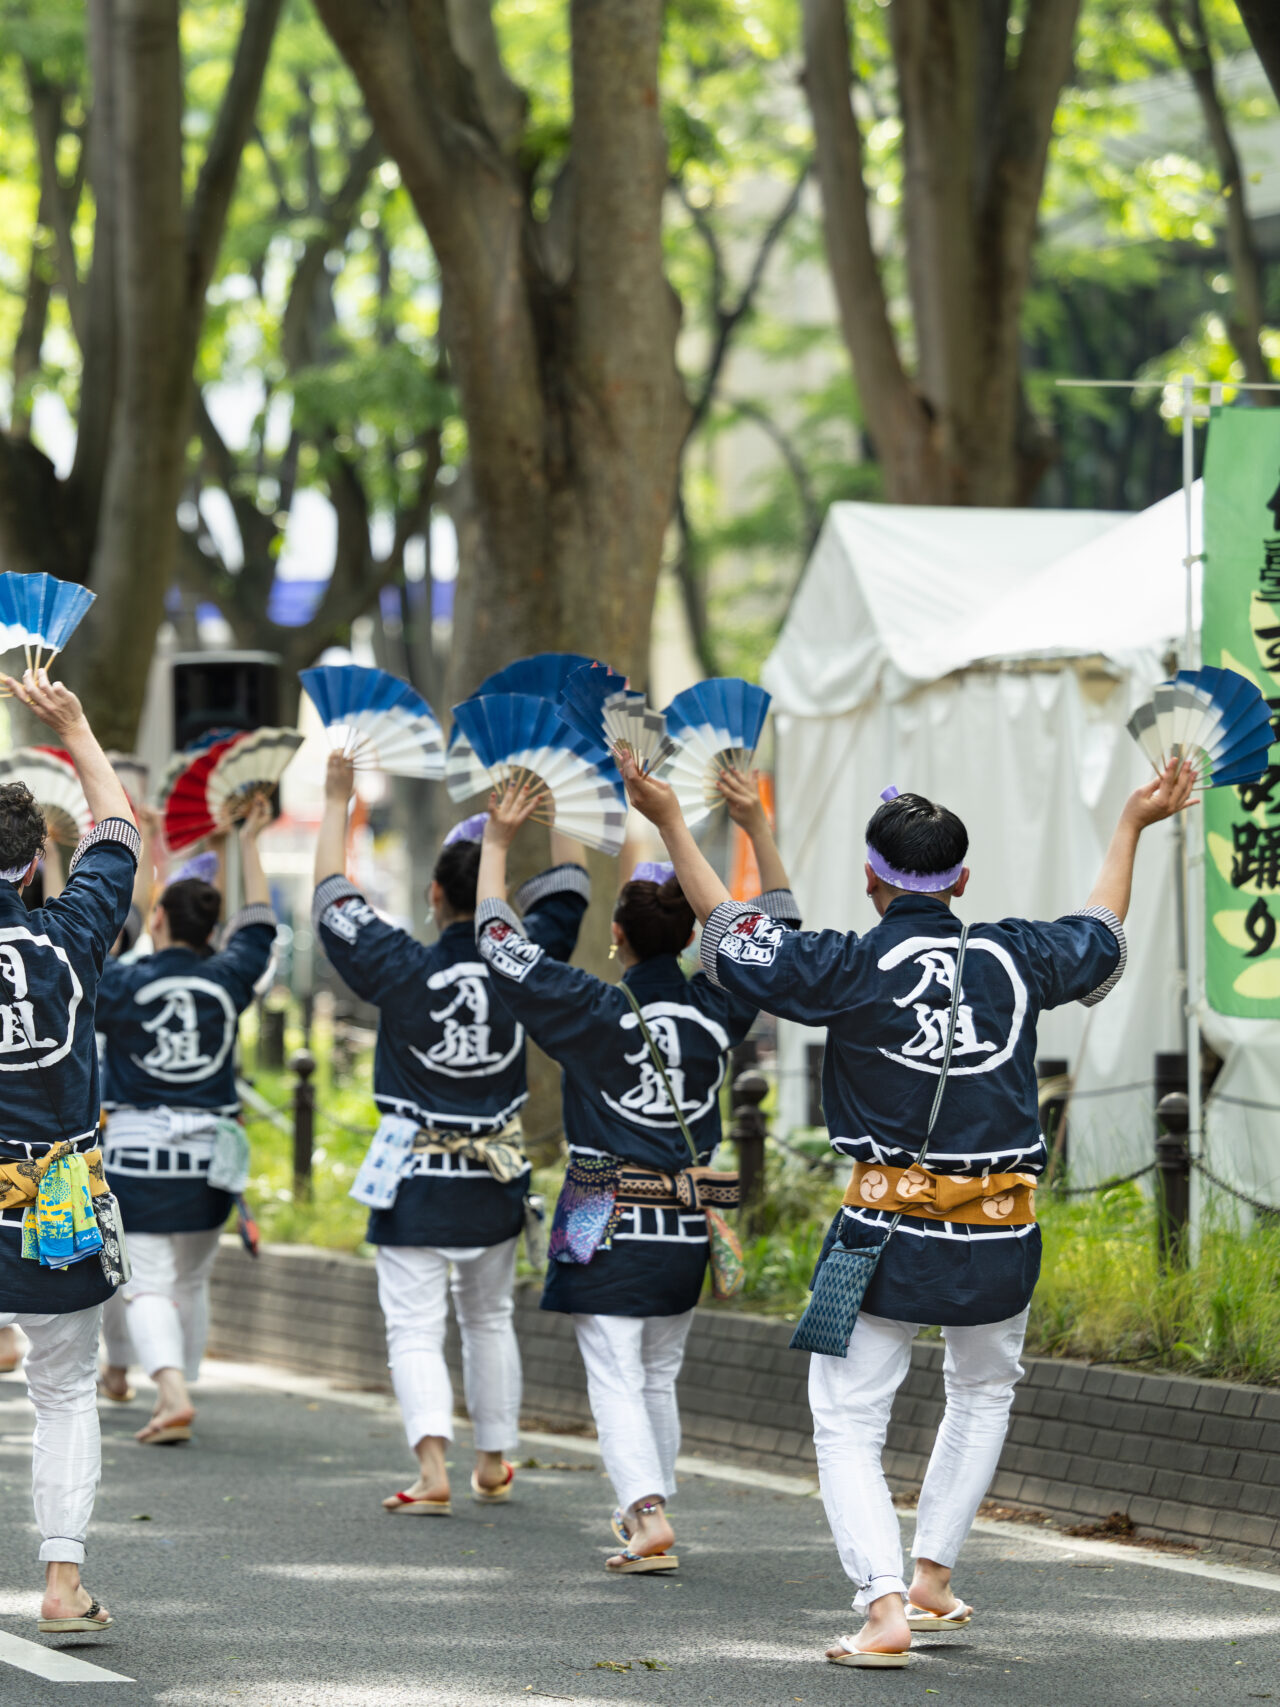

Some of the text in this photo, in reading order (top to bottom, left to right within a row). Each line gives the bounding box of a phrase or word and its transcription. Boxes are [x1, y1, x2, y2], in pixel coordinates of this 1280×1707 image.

[141, 989, 212, 1071] 月組
[427, 976, 503, 1067] 月組
[892, 949, 998, 1060] 月組
[619, 1016, 703, 1115] 月組
